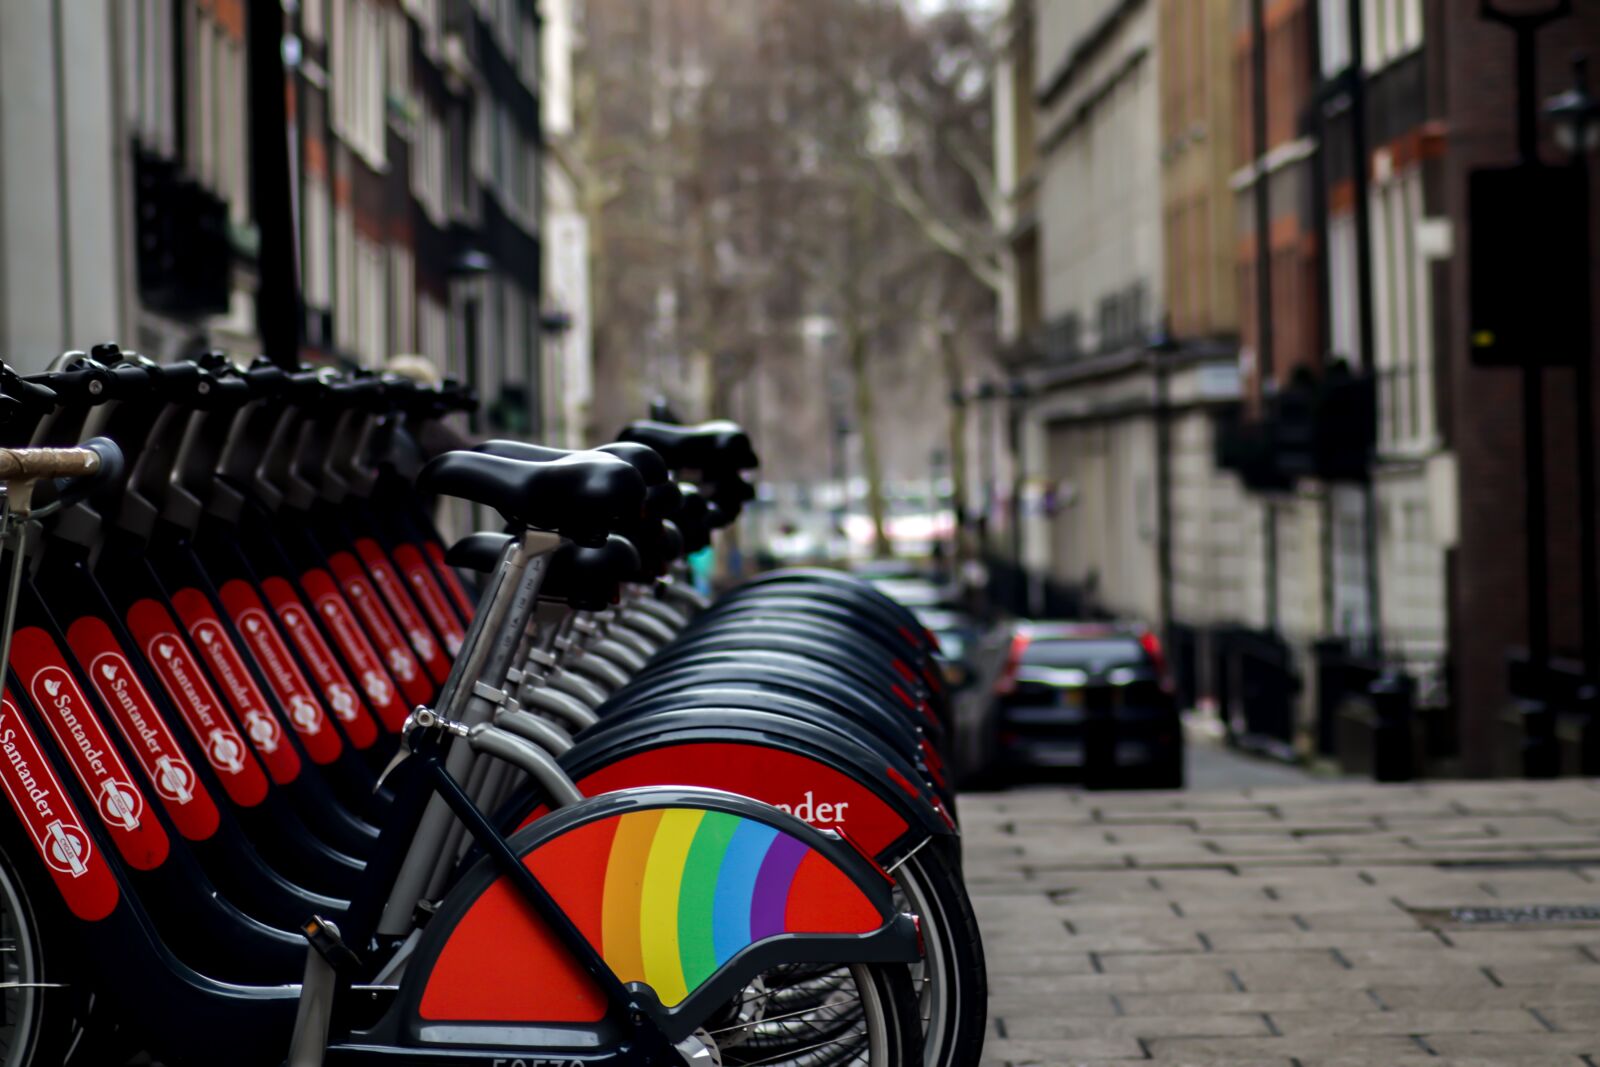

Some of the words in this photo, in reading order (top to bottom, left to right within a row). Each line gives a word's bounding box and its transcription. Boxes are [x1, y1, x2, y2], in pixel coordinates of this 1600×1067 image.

[167, 656, 215, 728] Santander
[208, 641, 251, 709] Santander
[53, 694, 108, 777] Santander
[111, 677, 162, 754] Santander
[0, 728, 53, 818] Santander
[59, 837, 75, 860] CYCLES
